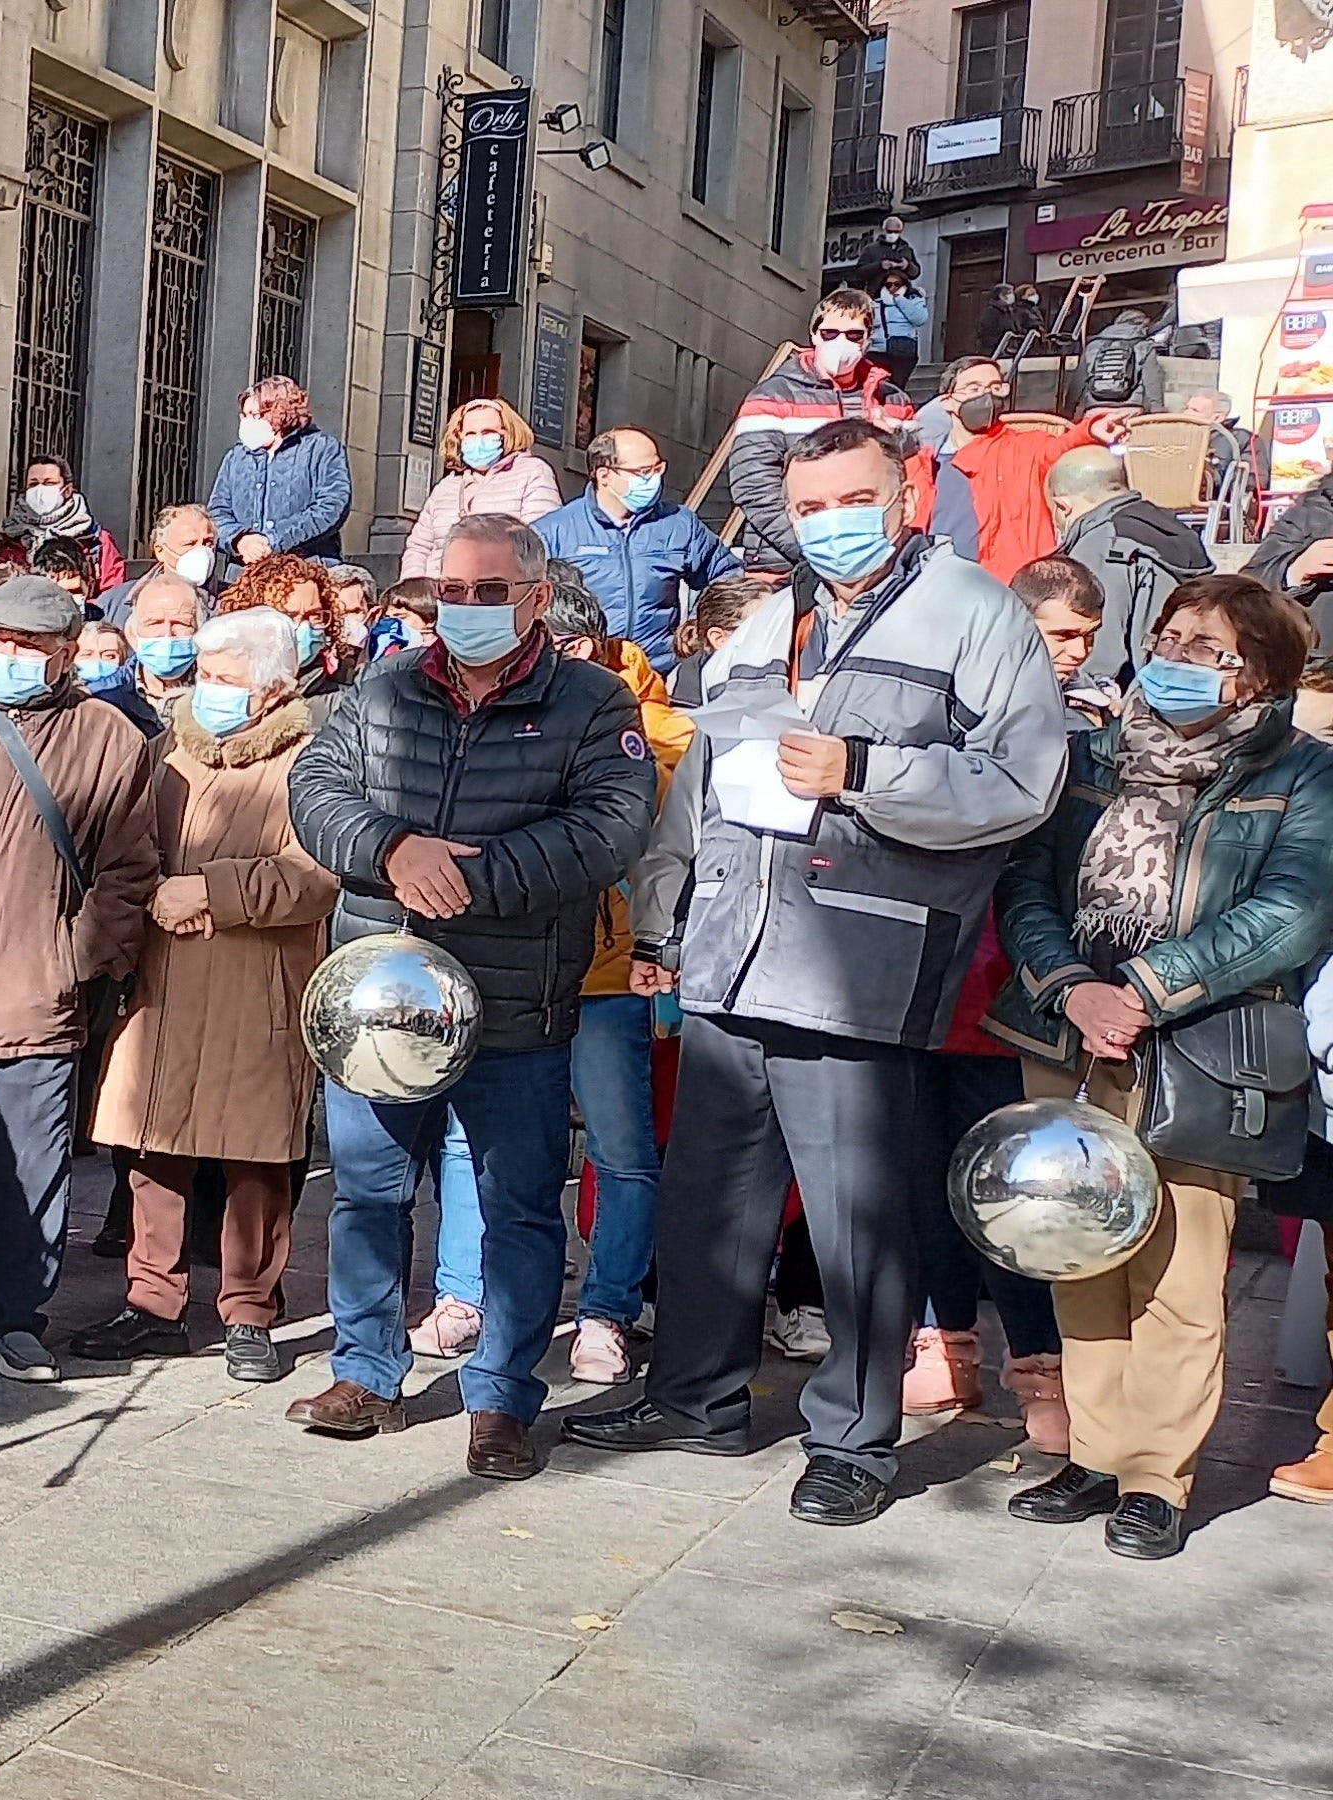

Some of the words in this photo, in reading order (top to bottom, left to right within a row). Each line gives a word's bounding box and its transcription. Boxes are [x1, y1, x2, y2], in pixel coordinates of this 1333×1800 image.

[469, 105, 525, 133] Orly
[1183, 144, 1203, 165] BAR
[1080, 208, 1132, 247] La
[1182, 235, 1219, 252] Bar
